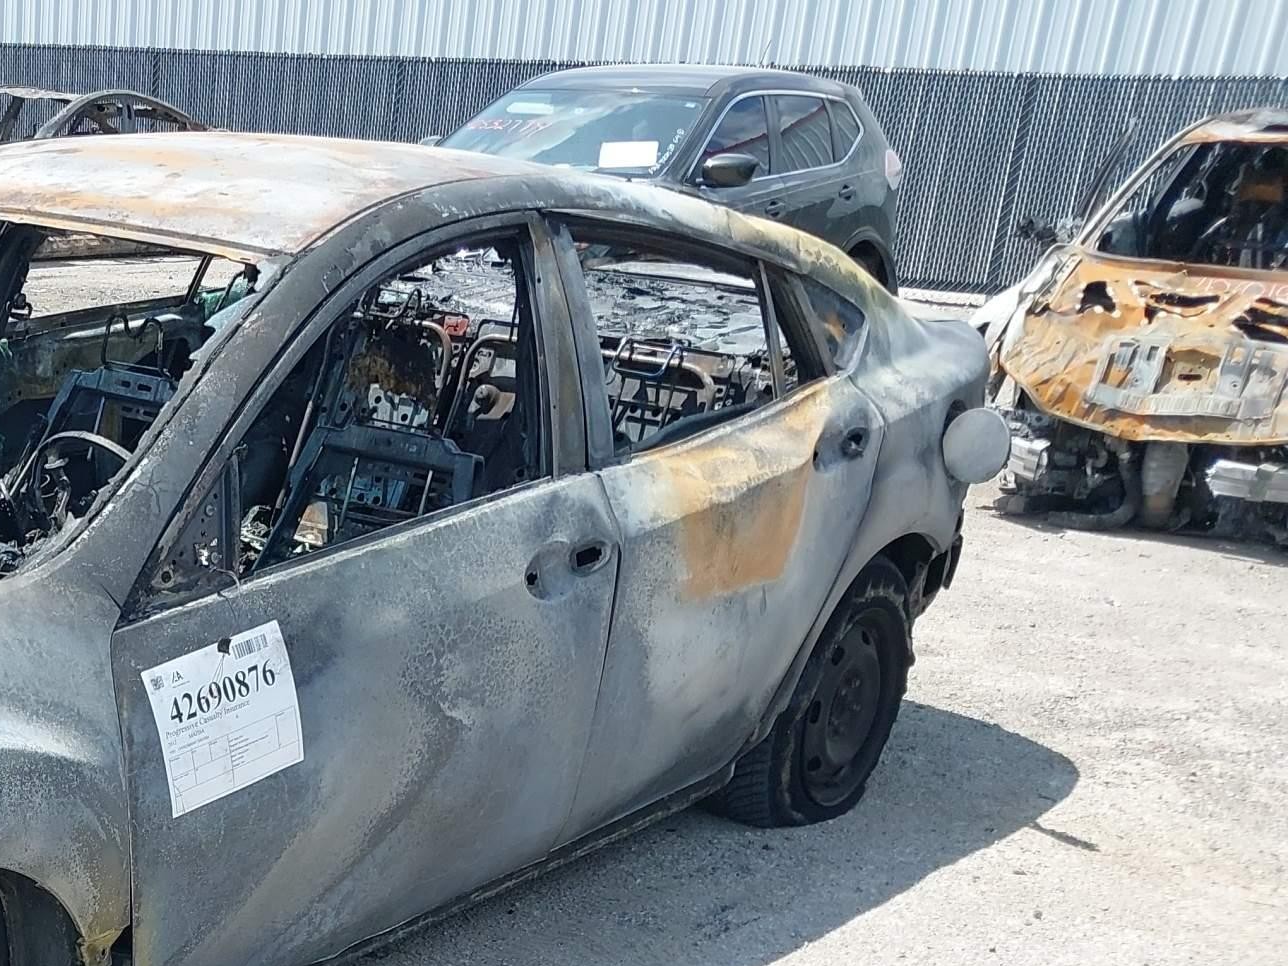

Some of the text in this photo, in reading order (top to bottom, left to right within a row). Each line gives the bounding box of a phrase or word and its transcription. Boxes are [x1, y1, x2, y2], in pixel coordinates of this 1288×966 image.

[170, 658, 276, 724] 42690876
[165, 700, 250, 739] Progressive Casualty Insurance
